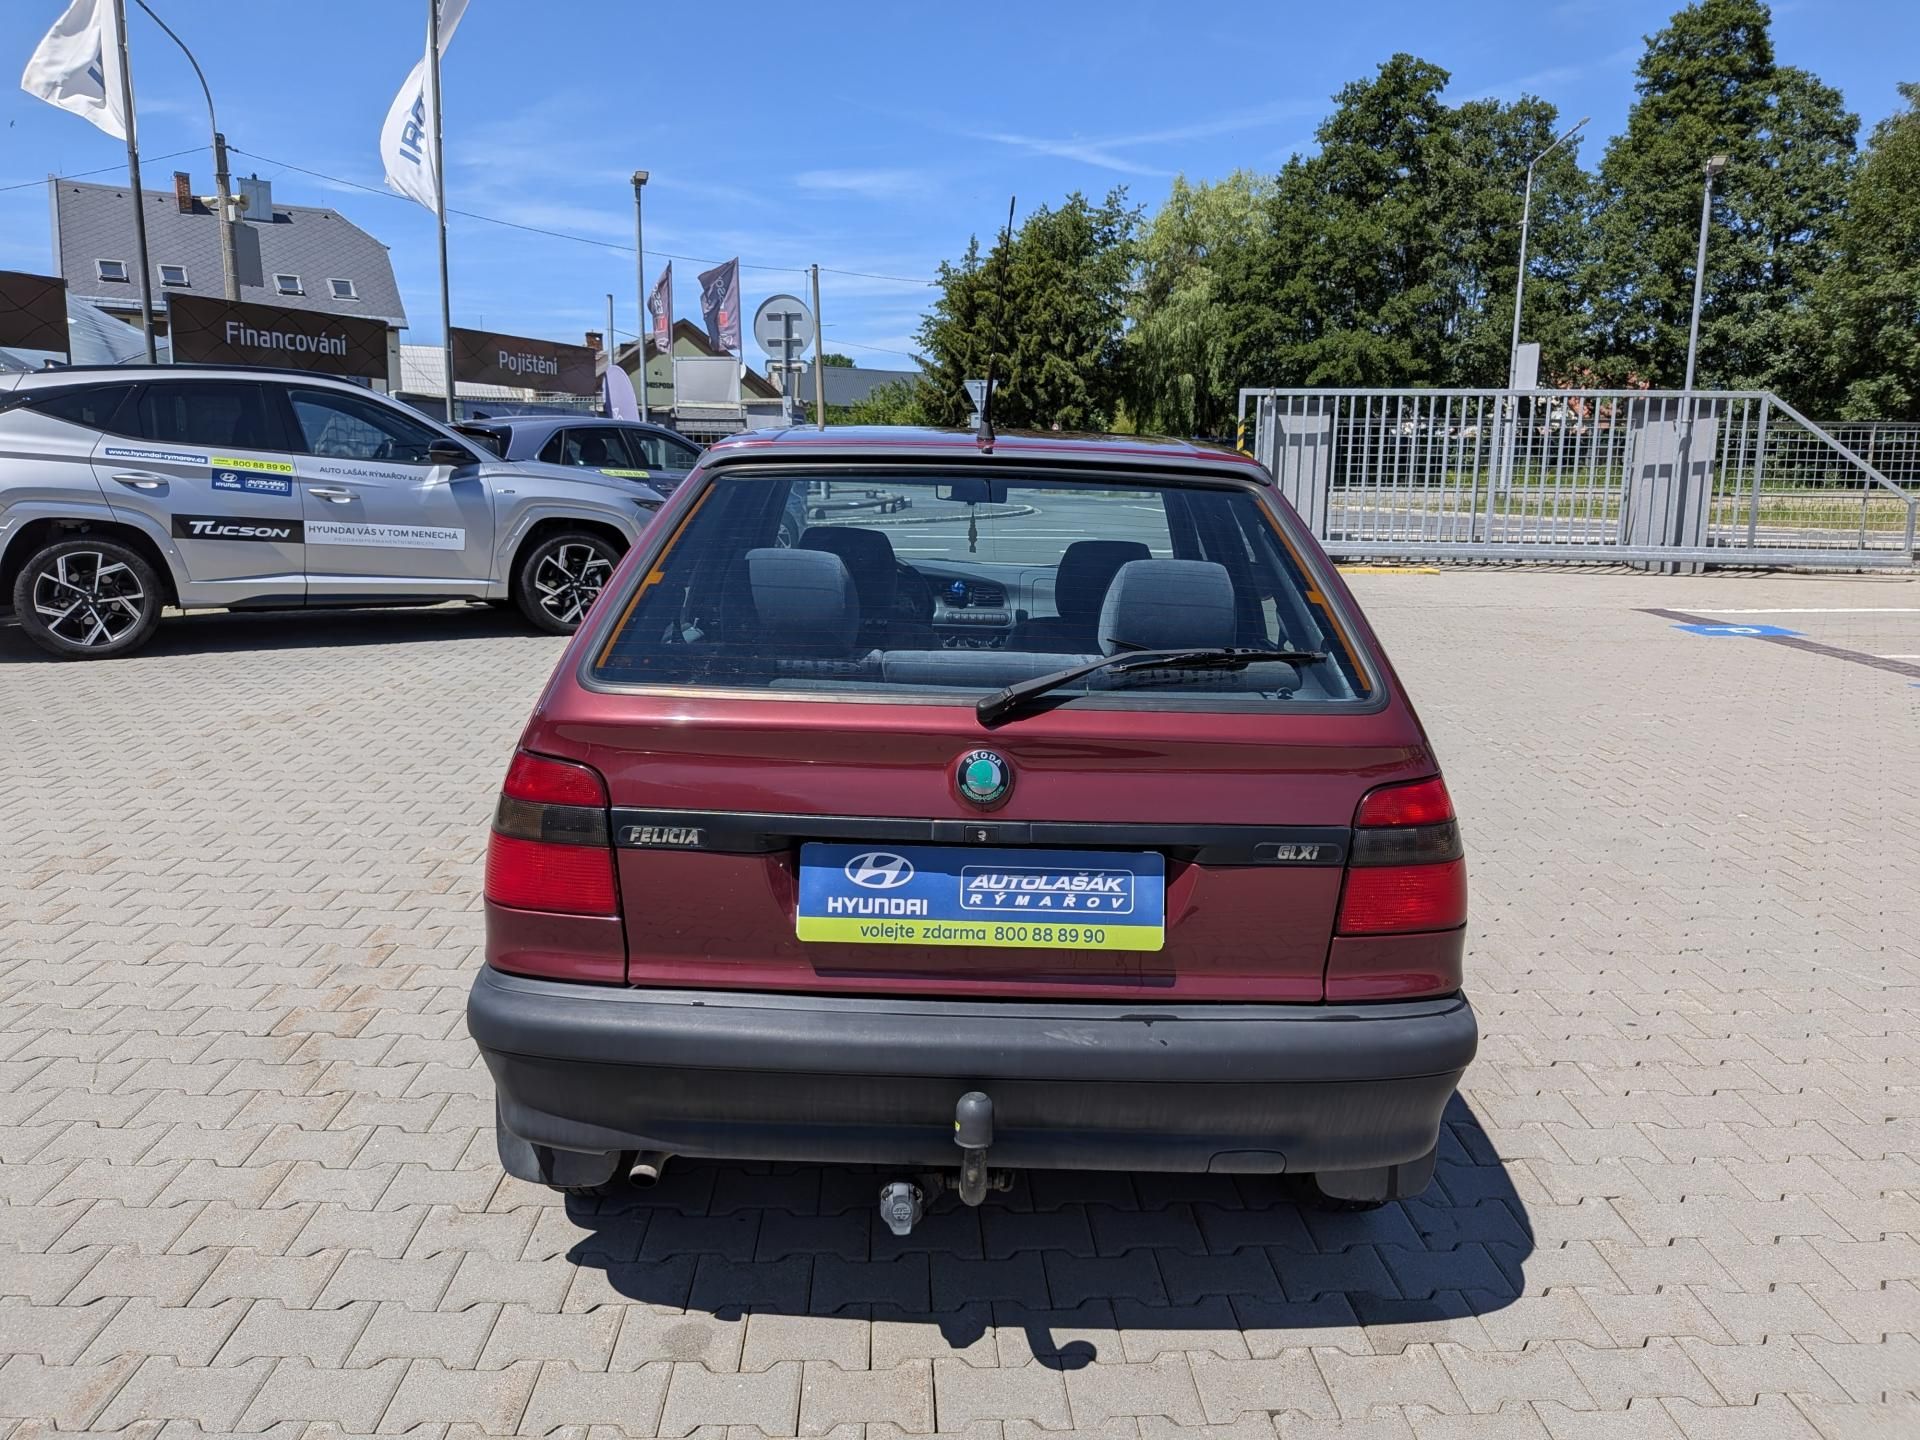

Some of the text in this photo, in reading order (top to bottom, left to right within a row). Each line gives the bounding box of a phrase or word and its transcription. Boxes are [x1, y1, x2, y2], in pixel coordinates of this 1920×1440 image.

[225, 320, 347, 356] Financování
[498, 350, 558, 376] Pojištění
[279, 464, 292, 472] 90
[319, 466, 341, 474] AUTO
[189, 520, 291, 538] TUCSON
[308, 525, 458, 540] HYUNDAI VÁS V TOM NENECHÁ
[629, 827, 699, 845] FELICIA
[969, 872, 1125, 892] AUTOLAŠÁK
[827, 896, 928, 916] HYUNDAI
[860, 923, 1106, 944] volejte zdarma 800 88 89 90
